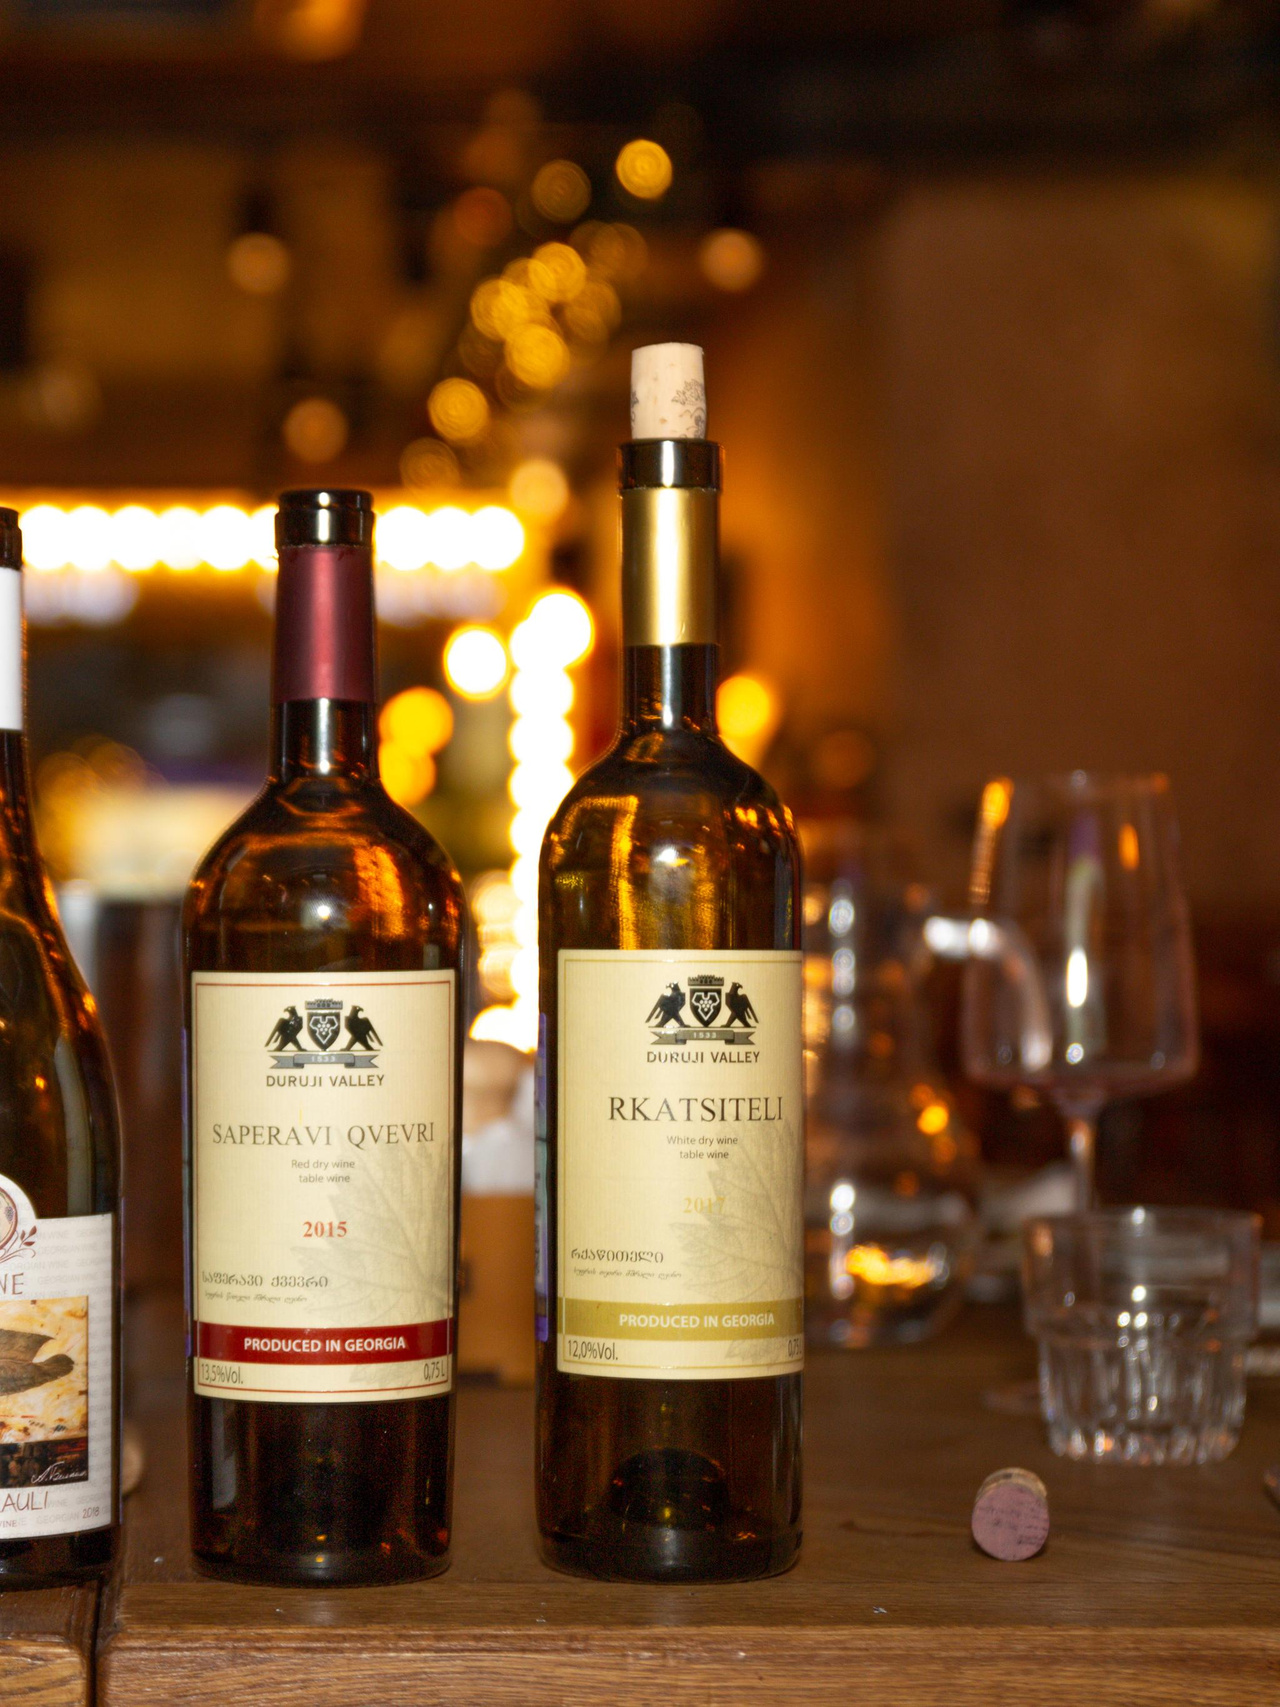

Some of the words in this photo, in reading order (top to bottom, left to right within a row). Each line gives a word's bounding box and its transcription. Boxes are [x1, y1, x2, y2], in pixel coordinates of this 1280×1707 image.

[646, 1051, 704, 1063] DURUJI
[710, 1051, 760, 1063] VALLEY
[266, 1075, 322, 1087] DURUJI
[329, 1074, 385, 1087] VALLEY
[608, 1096, 783, 1122] RKATSITELI
[212, 1124, 332, 1146] SAPERAVI
[347, 1122, 434, 1150] QVEVRI
[666, 1135, 696, 1145] White
[698, 1135, 714, 1147] dry
[716, 1136, 738, 1145] wine
[680, 1150, 704, 1159] table
[706, 1150, 729, 1159] wine
[291, 1160, 310, 1168] Red
[312, 1159, 329, 1171] dry
[331, 1160, 356, 1168] wine
[299, 1174, 324, 1183] table
[326, 1174, 350, 1183] wine
[682, 1197, 726, 1214] 2017
[302, 1220, 348, 1238] 2015
[570, 1248, 664, 1264] რქაწითელი
[202, 1271, 263, 1288] საფერავი
[270, 1276, 328, 1288] ქვევრი
[620, 1314, 700, 1328] PRODUCED
[704, 1315, 718, 1328] IN
[722, 1313, 775, 1328] GEORGIA
[244, 1338, 321, 1352] PRODUCED
[325, 1340, 341, 1352] IN
[345, 1336, 406, 1352] GEORGIA
[568, 1340, 618, 1361] 12,0%Vol.
[201, 1363, 244, 1385] 13,5%Vol.
